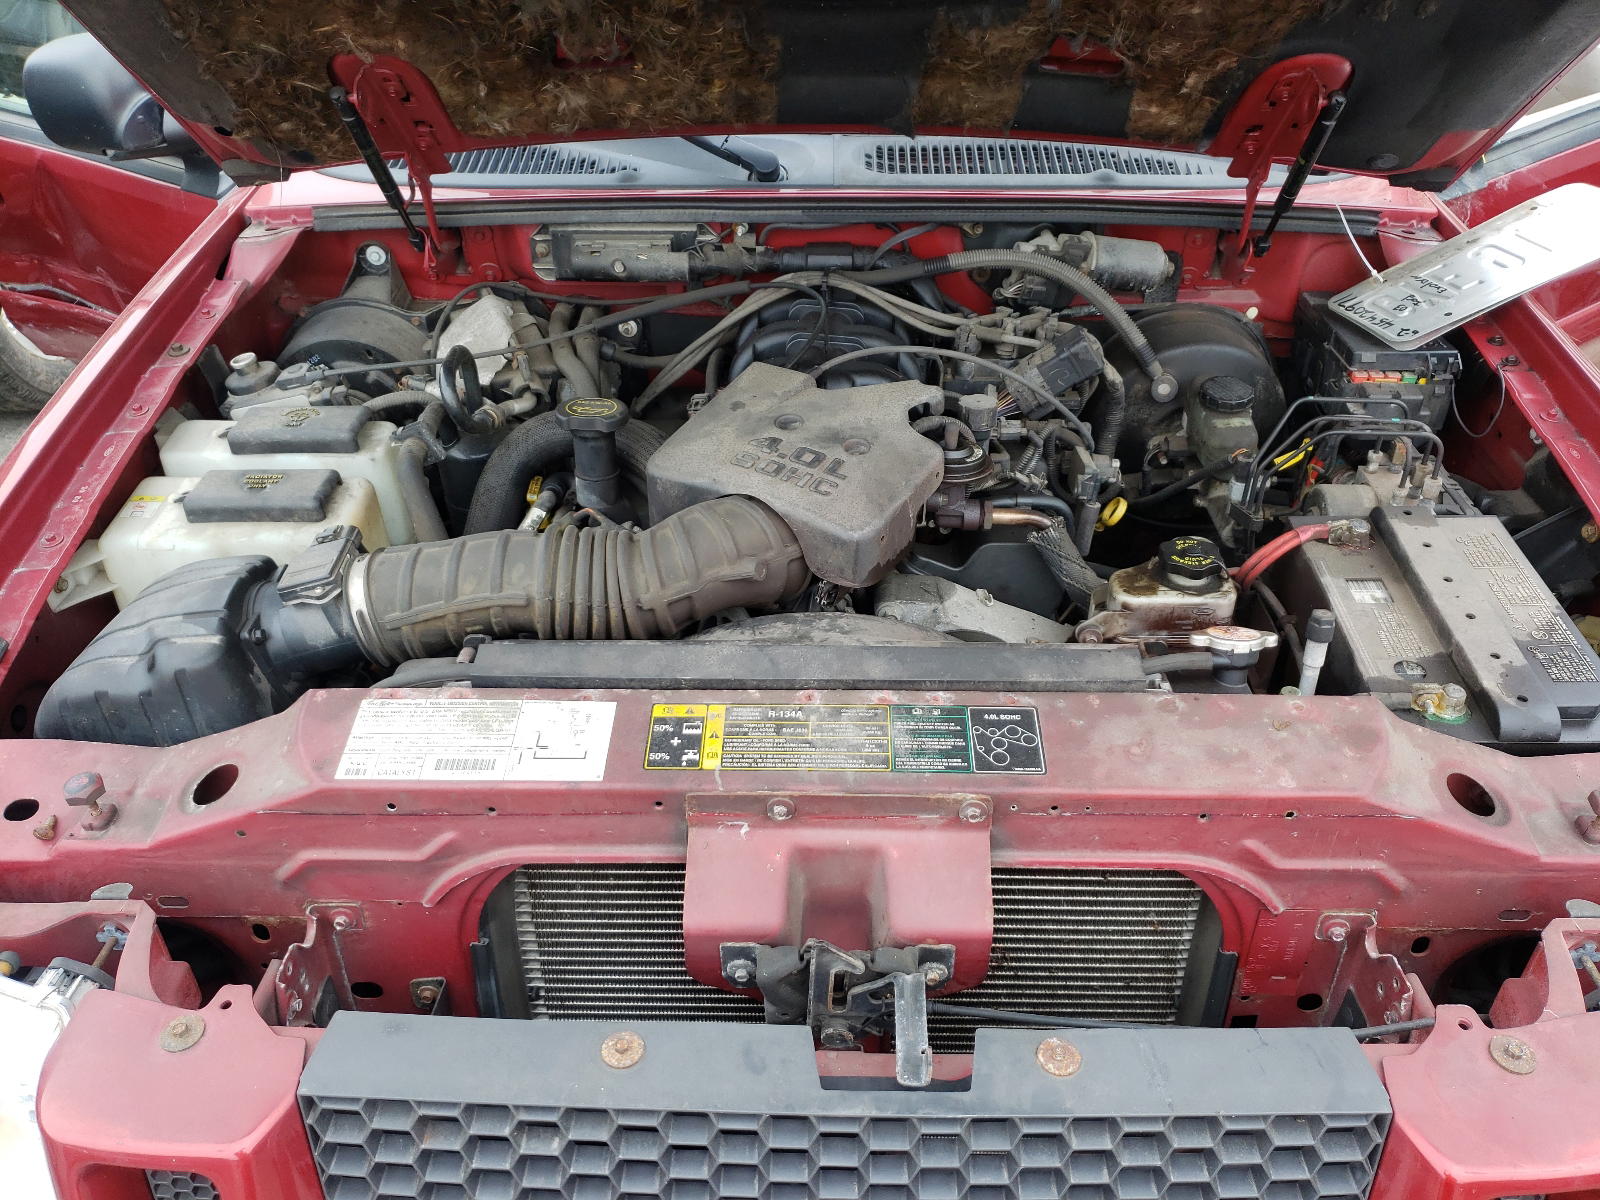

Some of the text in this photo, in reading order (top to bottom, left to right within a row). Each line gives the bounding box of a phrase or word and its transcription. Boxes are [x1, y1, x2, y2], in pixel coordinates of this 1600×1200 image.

[749, 436, 848, 481] 4.0L
[730, 450, 839, 497] SOHC
[768, 710, 803, 718] R-134A
[653, 724, 674, 732] 50%
[649, 752, 670, 760] 50%
